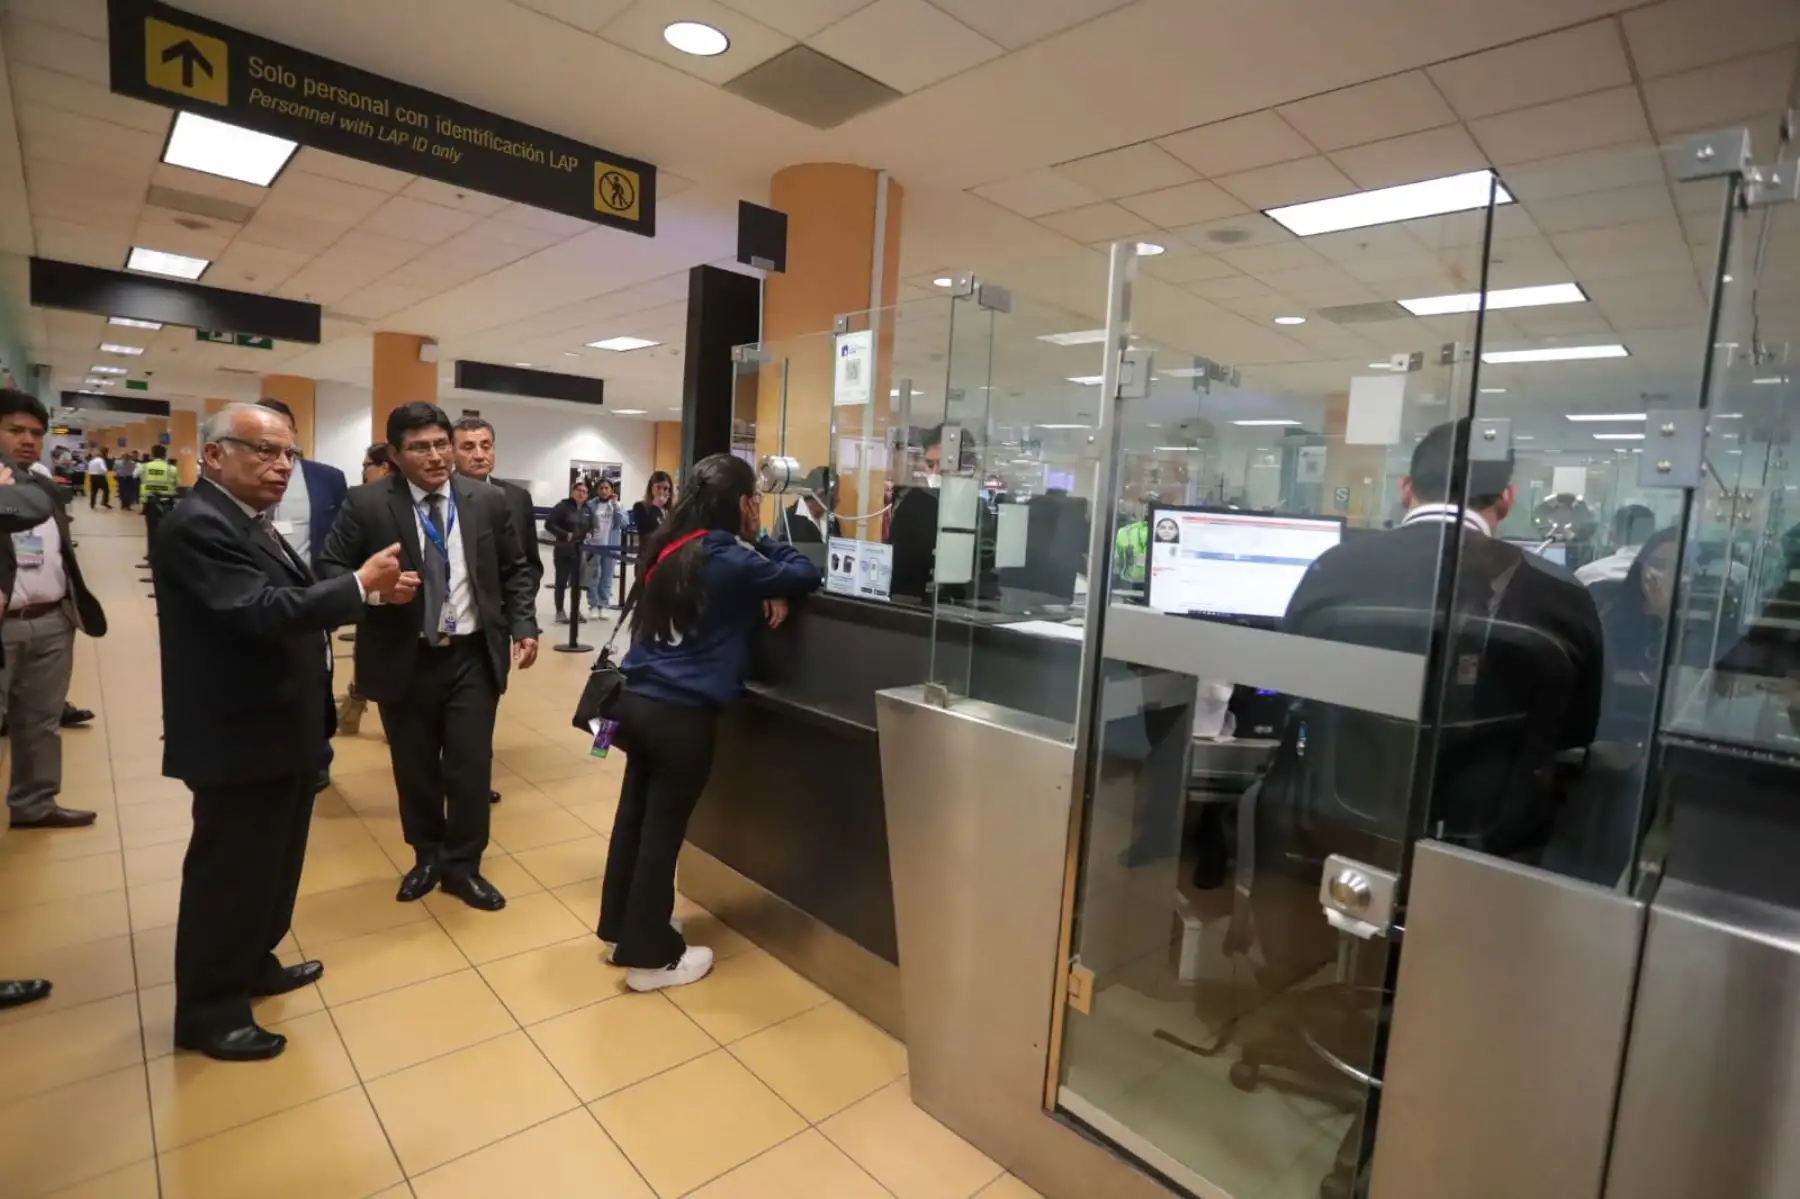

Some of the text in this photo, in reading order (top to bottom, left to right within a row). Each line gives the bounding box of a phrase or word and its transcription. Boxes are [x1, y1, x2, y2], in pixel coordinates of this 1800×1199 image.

[248, 56, 579, 172] Solo personal con identificación LAP
[248, 87, 463, 164] Personnel with LAP ID only
[1336, 487, 1349, 502] S
